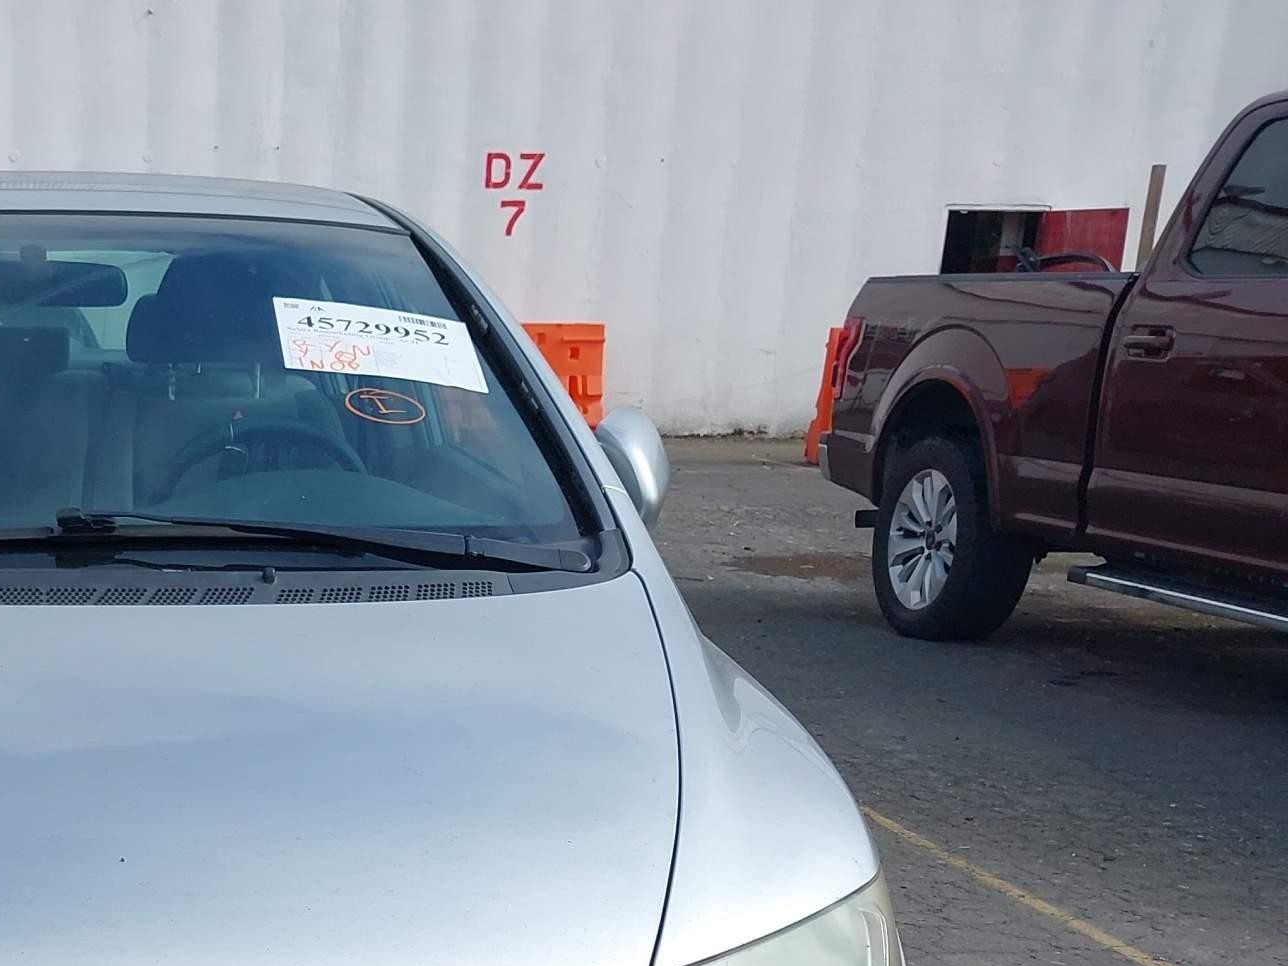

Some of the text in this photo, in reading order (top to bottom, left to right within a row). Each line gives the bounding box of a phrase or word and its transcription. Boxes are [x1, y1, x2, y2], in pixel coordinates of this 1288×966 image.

[485, 153, 545, 190] DZ
[500, 200, 526, 236] 7
[297, 315, 449, 345] 45729952
